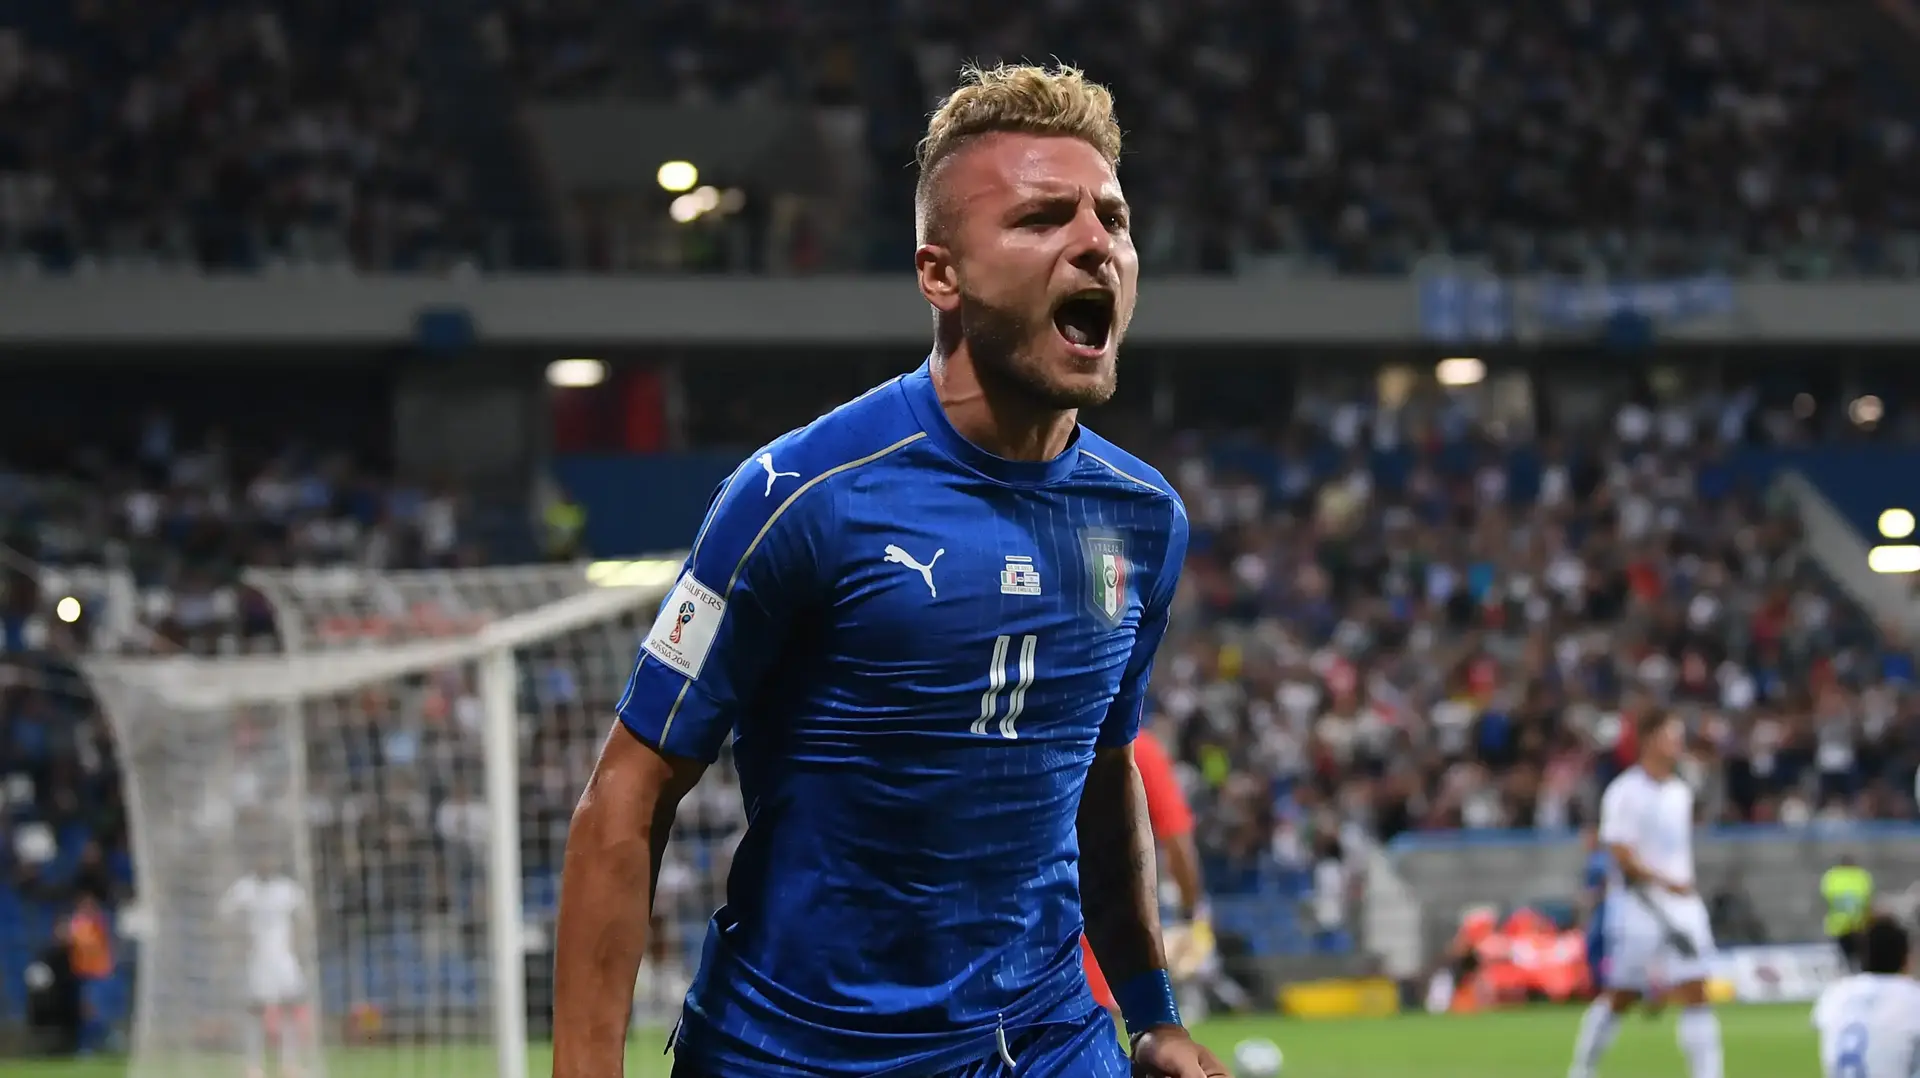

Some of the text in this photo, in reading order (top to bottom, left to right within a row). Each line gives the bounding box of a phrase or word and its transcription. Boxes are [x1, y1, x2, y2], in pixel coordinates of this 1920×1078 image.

[1094, 543, 1119, 553] ITALIA
[681, 578, 723, 611] UALIFIERS
[650, 639, 672, 658] RUSSIA
[672, 653, 691, 669] 2018
[970, 635, 1037, 739] 11
